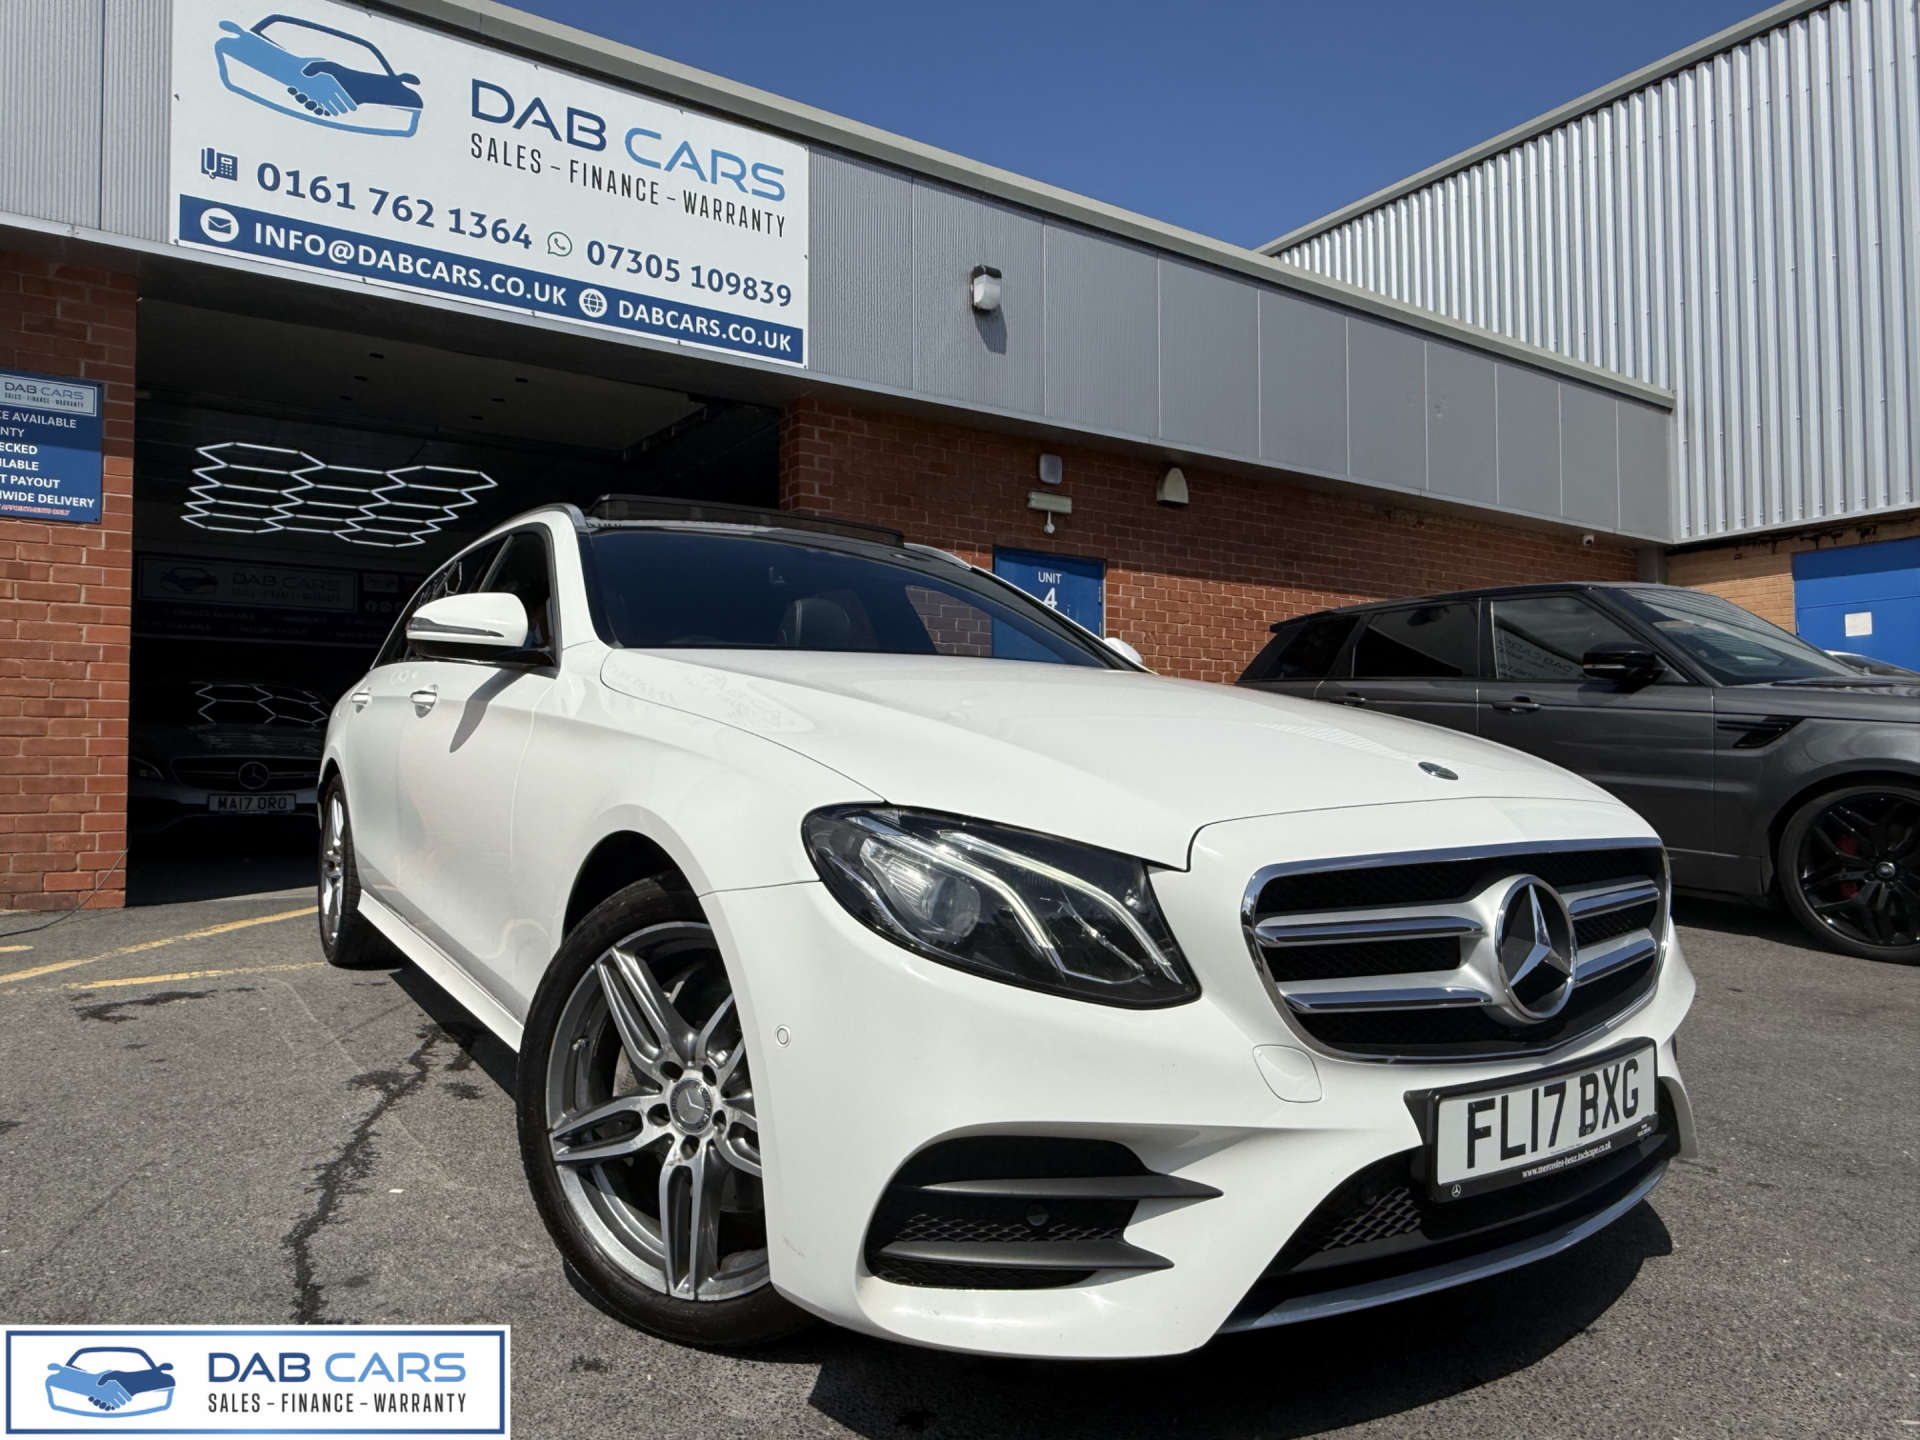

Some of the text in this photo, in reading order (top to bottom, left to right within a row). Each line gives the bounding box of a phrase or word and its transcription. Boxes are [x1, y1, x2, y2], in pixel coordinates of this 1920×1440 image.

[472, 78, 786, 202] DAB CARS
[470, 133, 542, 174] SALES
[569, 159, 660, 205] FINANCE
[683, 189, 786, 238] WARRANTY
[256, 162, 533, 249] 0161 762 1364
[254, 222, 567, 307] INFO@DABCARS.CO.UK
[586, 240, 792, 307] 07305 109839
[618, 299, 792, 352] DABCARS.CO.UK
[4, 381, 84, 400] DAB CARS
[0, 426, 25, 437] NTY
[12, 411, 77, 429] AVAILABLE
[0, 490, 95, 508] WIDE DELIVERY
[10, 475, 61, 489] PAYOUT
[1037, 570, 1062, 585] UNIT
[1043, 586, 1058, 609] 4
[1466, 1057, 1639, 1170] FL17 BXG
